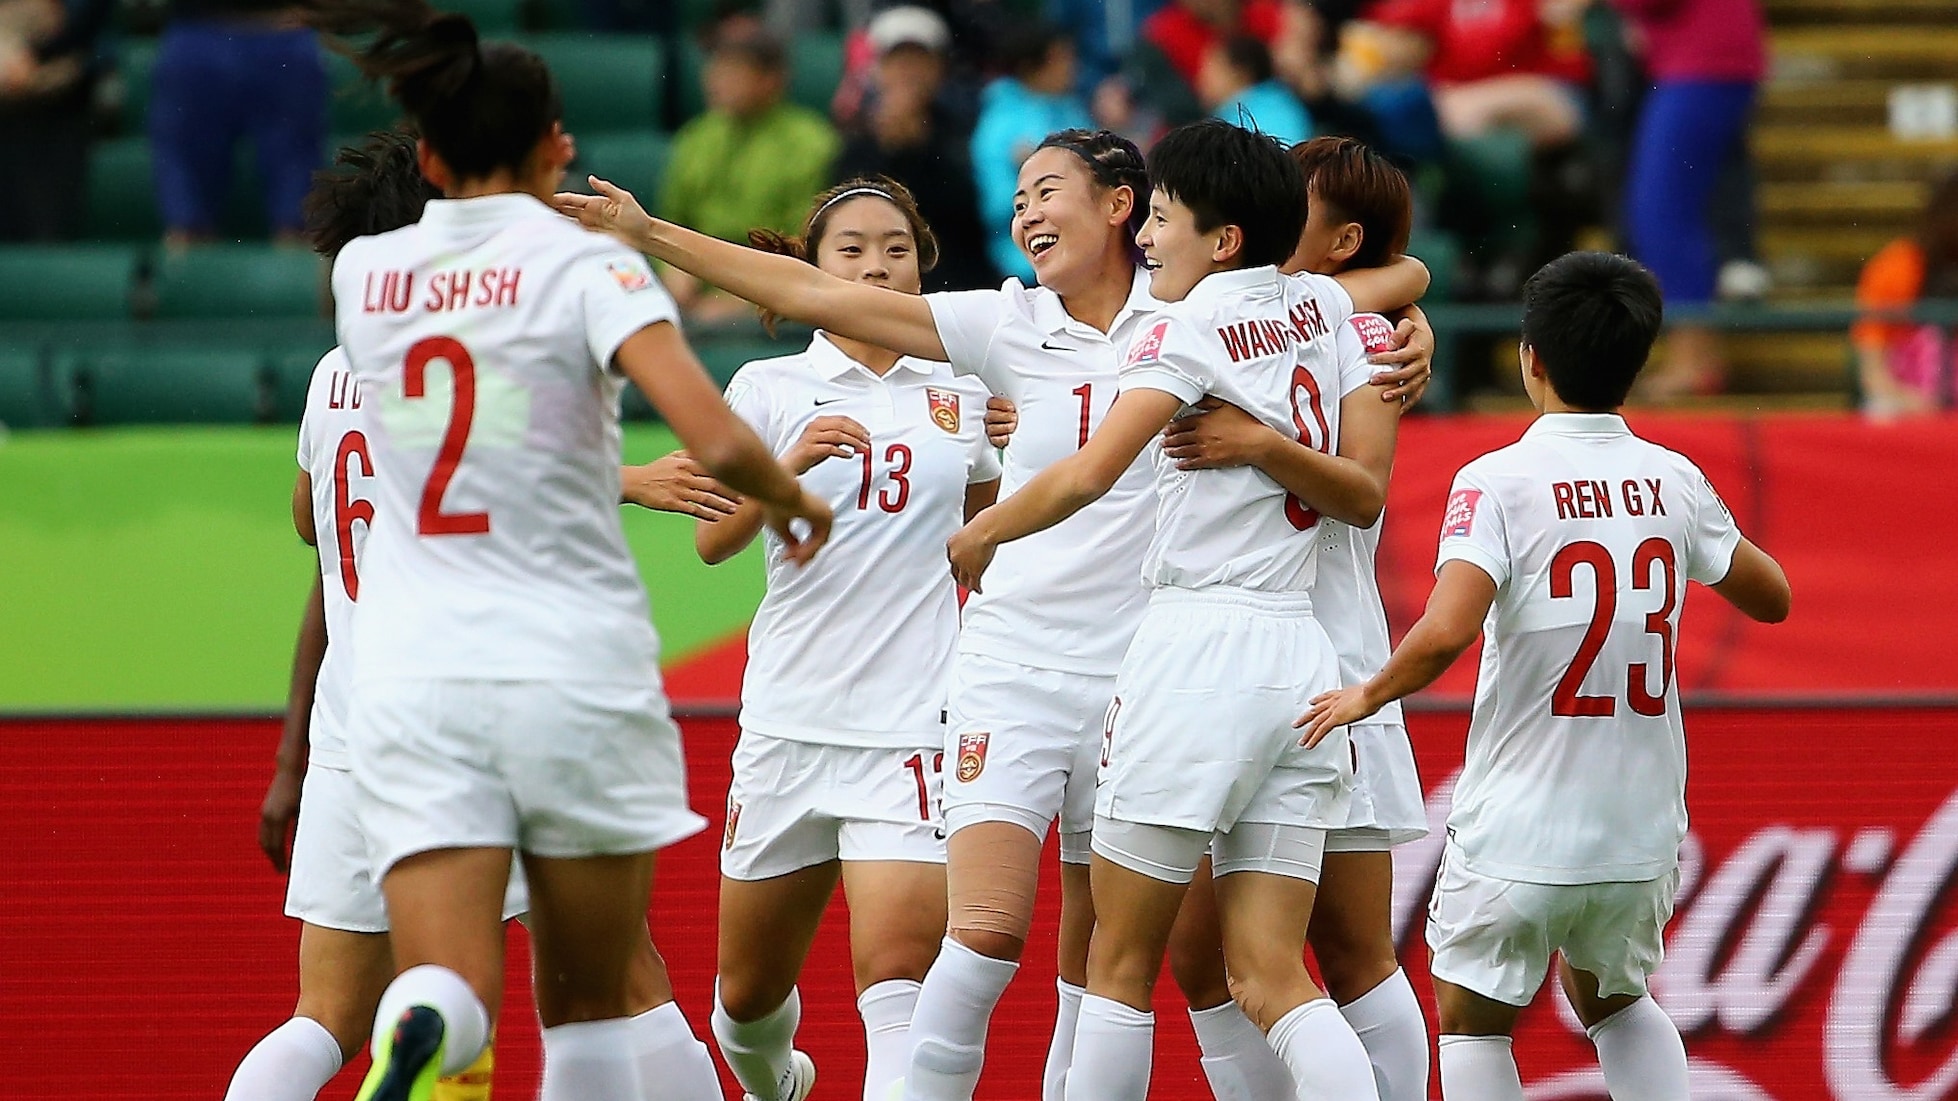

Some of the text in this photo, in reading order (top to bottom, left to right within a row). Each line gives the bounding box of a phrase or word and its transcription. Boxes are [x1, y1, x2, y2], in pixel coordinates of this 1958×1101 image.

[363, 271, 413, 312] LIU
[405, 335, 490, 536] 2
[854, 442, 913, 514] 13
[333, 429, 376, 603] 6
[1553, 480, 1613, 520] REN
[1549, 536, 1677, 718] 23
